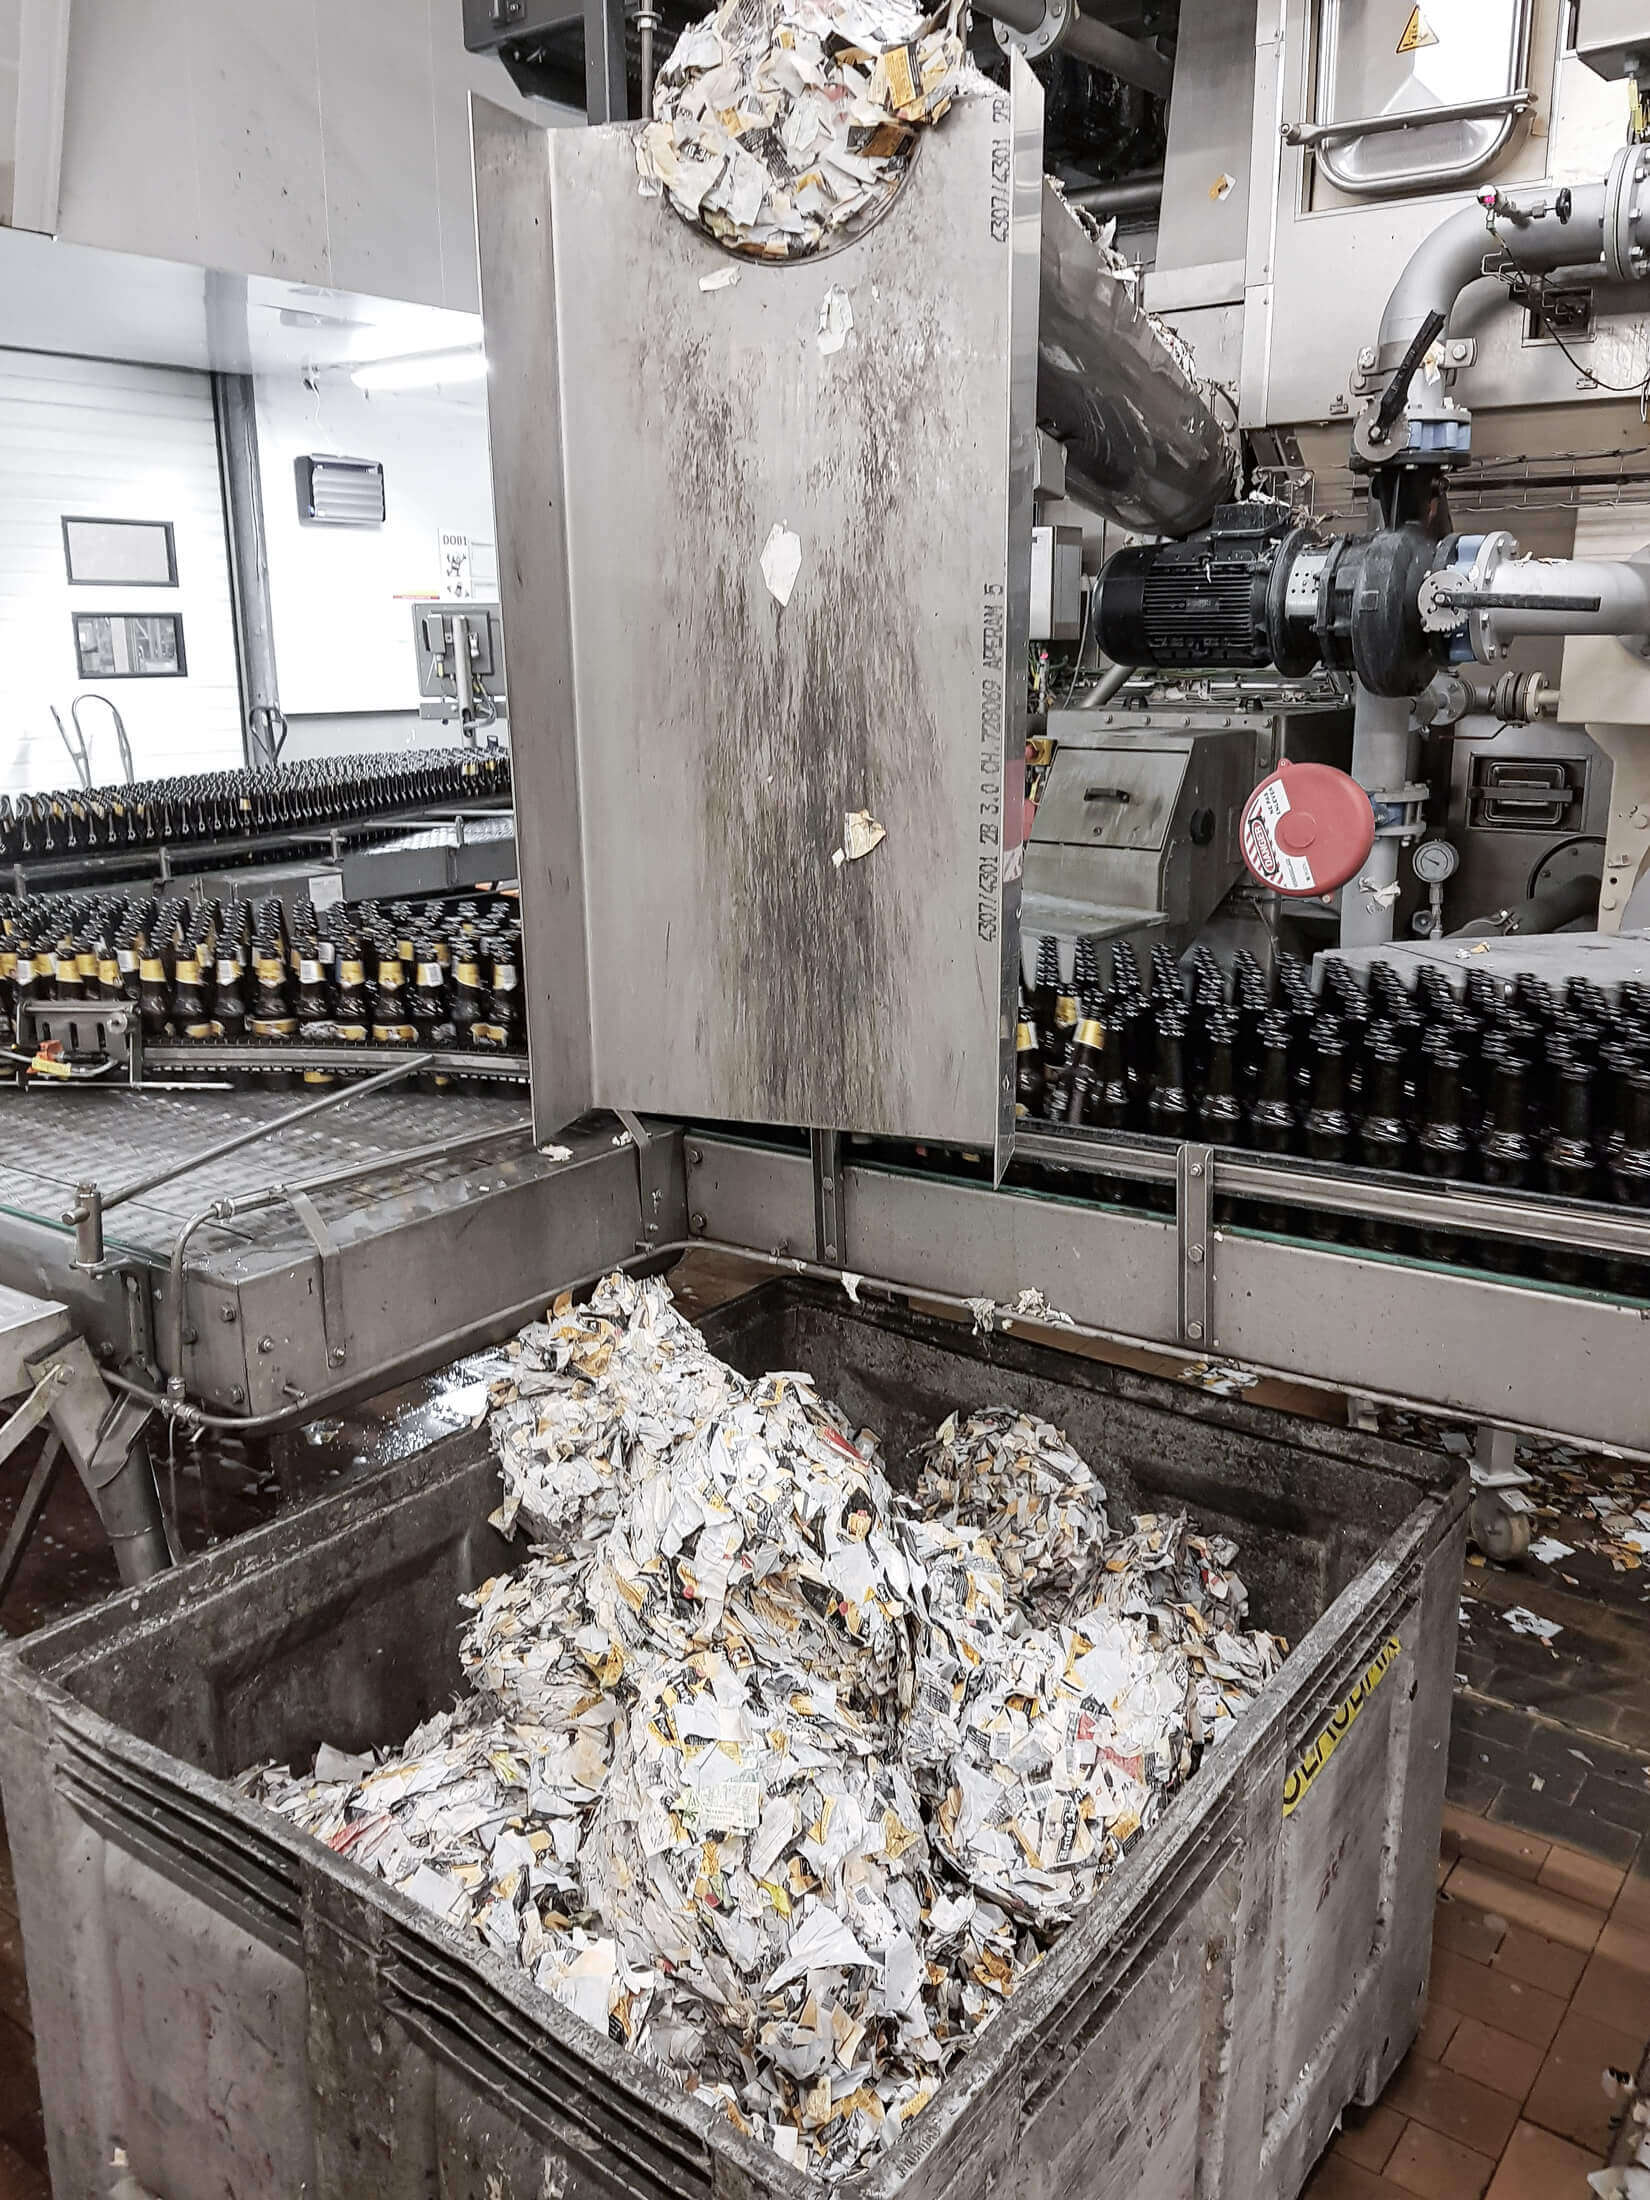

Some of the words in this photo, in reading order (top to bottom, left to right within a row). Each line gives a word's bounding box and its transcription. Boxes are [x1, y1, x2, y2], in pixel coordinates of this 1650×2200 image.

[984, 583, 1003, 596] 5
[980, 783, 1000, 815] 3.0
[1254, 825, 1273, 867] DANGER
[978, 856, 998, 943] 4307/4301
